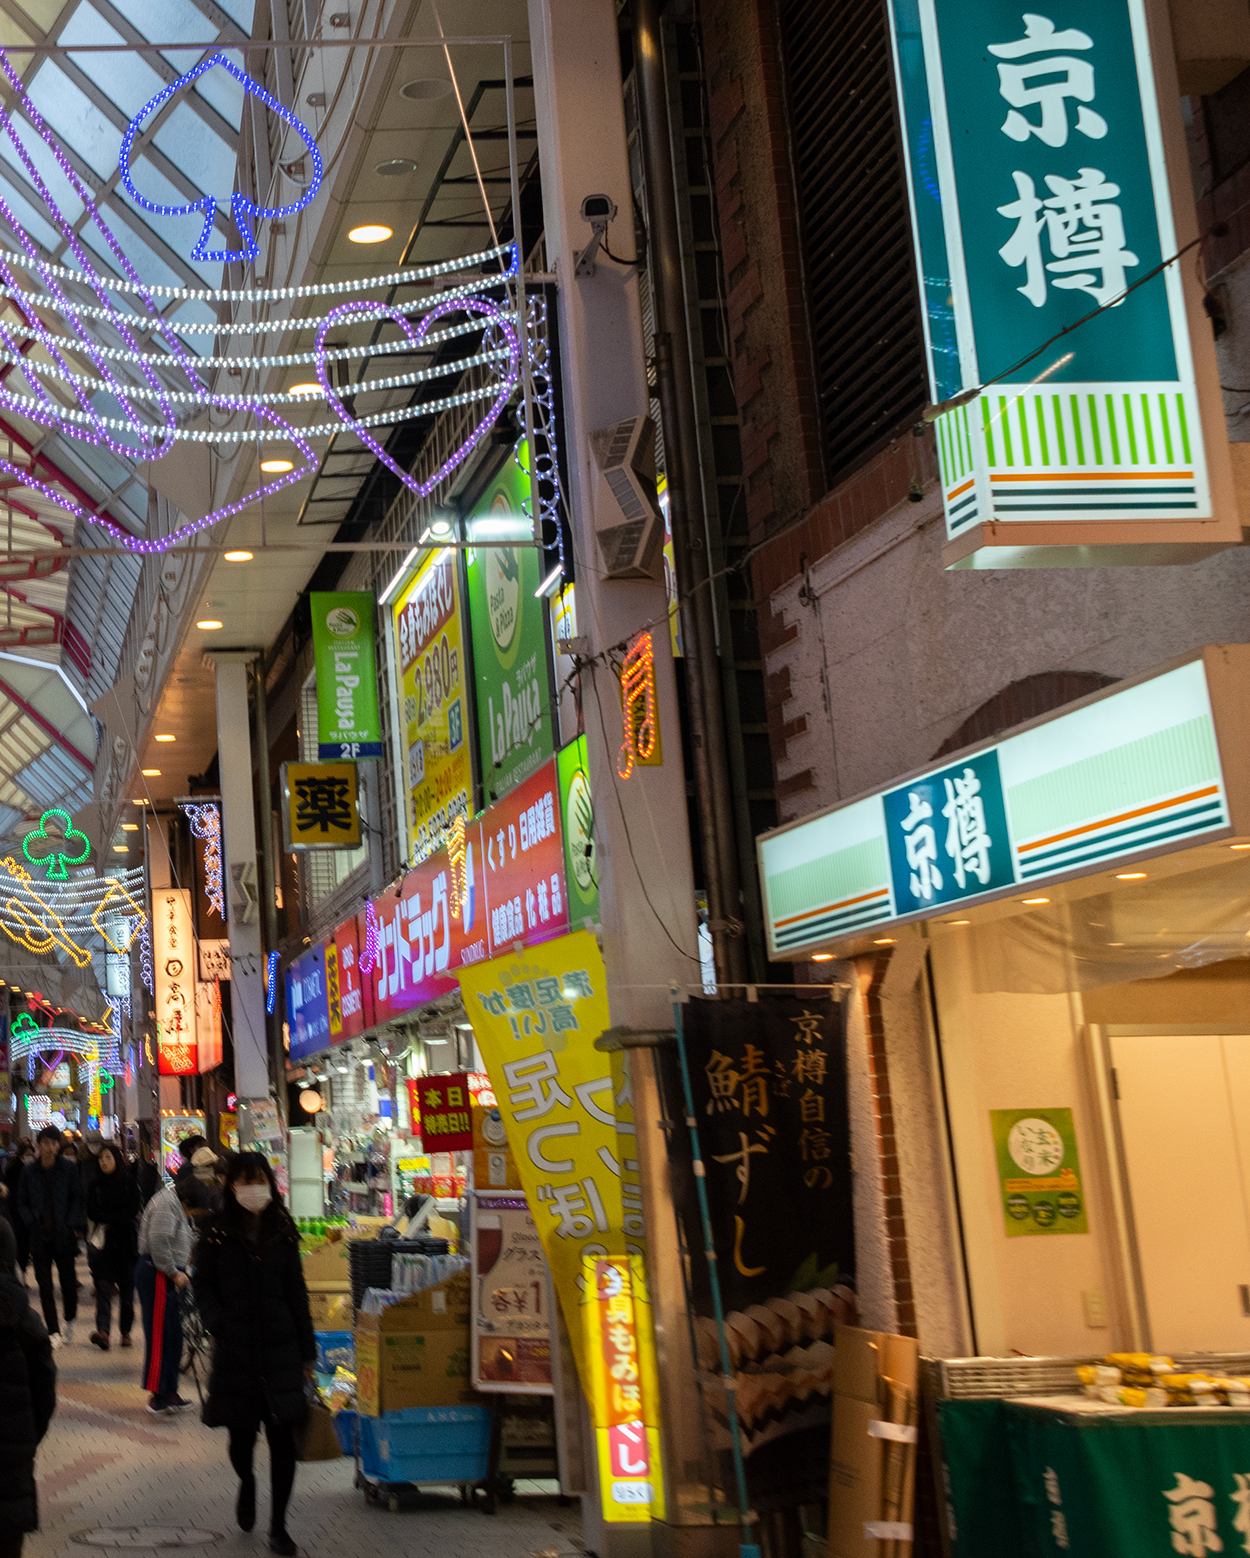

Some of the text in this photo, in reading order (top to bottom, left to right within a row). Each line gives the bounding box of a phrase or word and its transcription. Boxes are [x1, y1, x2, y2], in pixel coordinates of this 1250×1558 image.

[987, 13, 1140, 307] 京樽
[340, 742, 361, 759] 2F
[294, 777, 353, 833] 薬
[488, 823, 517, 872] くすり
[900, 768, 992, 900] 京樽
[377, 870, 450, 1001] サンドラッグ
[526, 873, 562, 929] 化粧品
[424, 1085, 464, 1109] 本日
[789, 1009, 833, 1189] 京樽自信の
[705, 1043, 777, 1278] 鯖ずし
